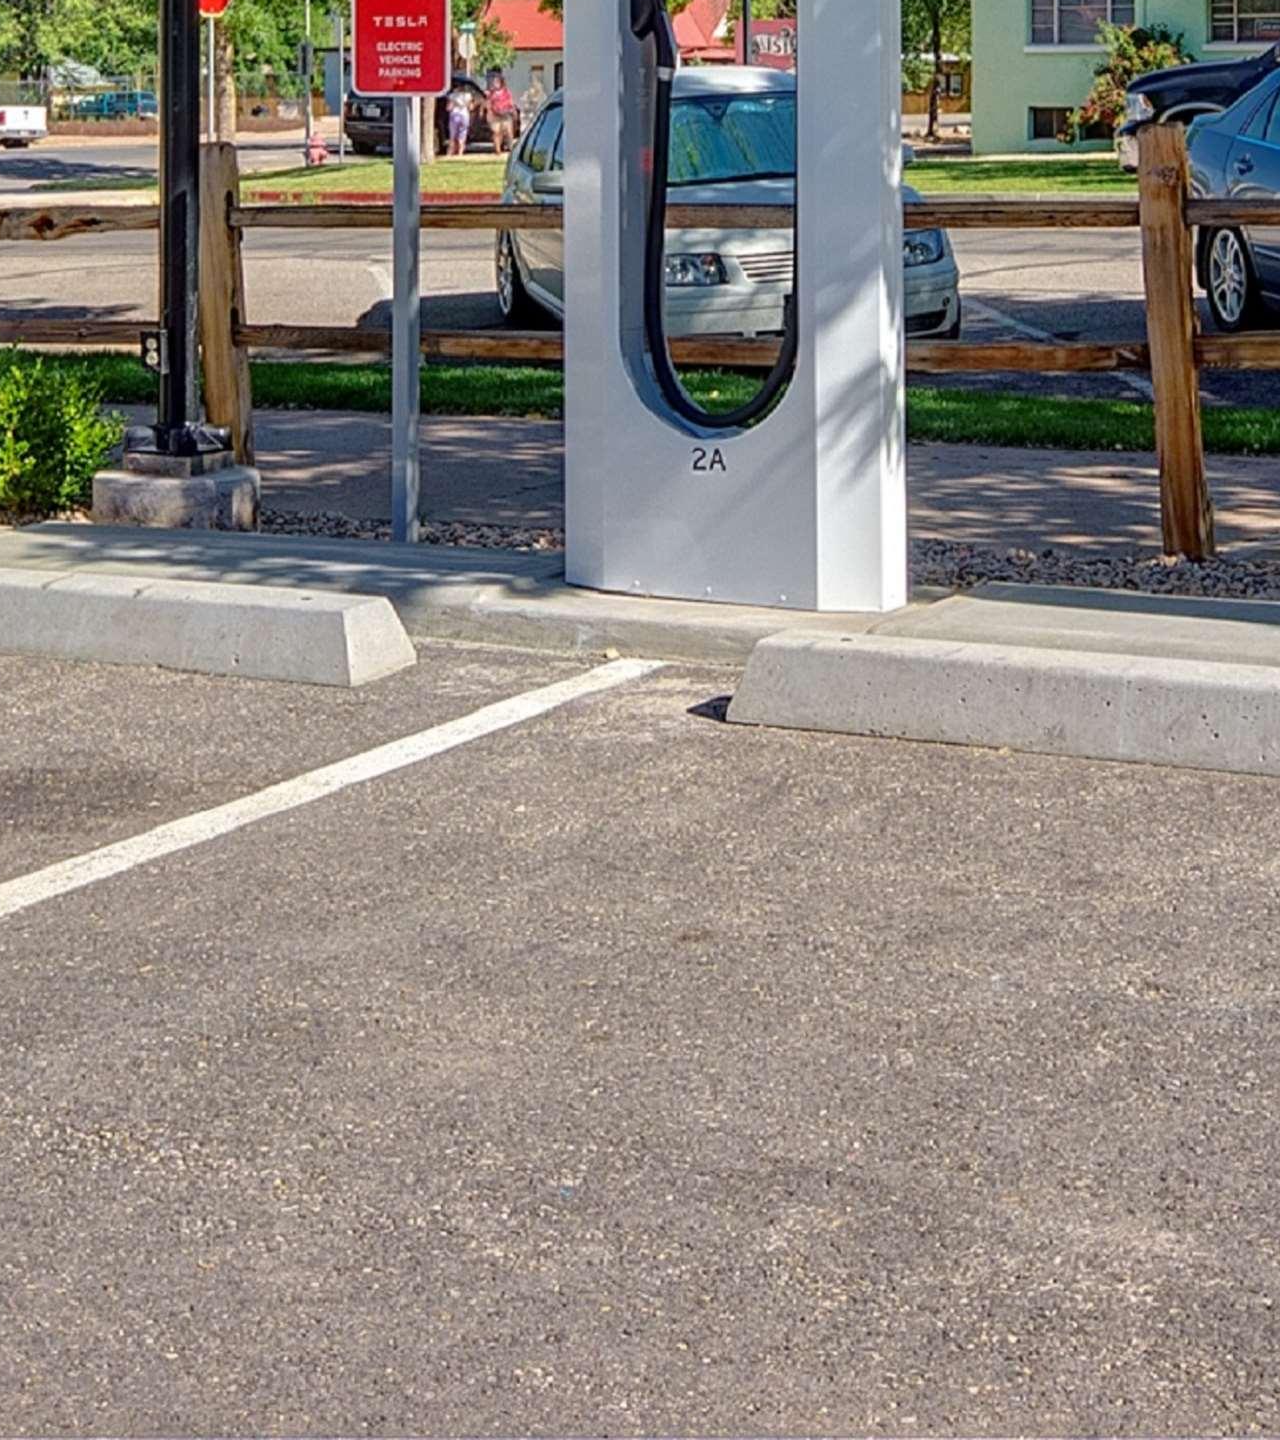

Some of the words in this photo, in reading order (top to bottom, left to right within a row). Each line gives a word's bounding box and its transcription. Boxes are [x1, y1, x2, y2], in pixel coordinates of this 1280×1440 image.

[372, 16, 428, 28] TESLA
[376, 41, 424, 52] ELECTRIC
[378, 54, 422, 65] VEHICLE
[377, 67, 422, 78] PARKING
[692, 447, 726, 471] 2A
